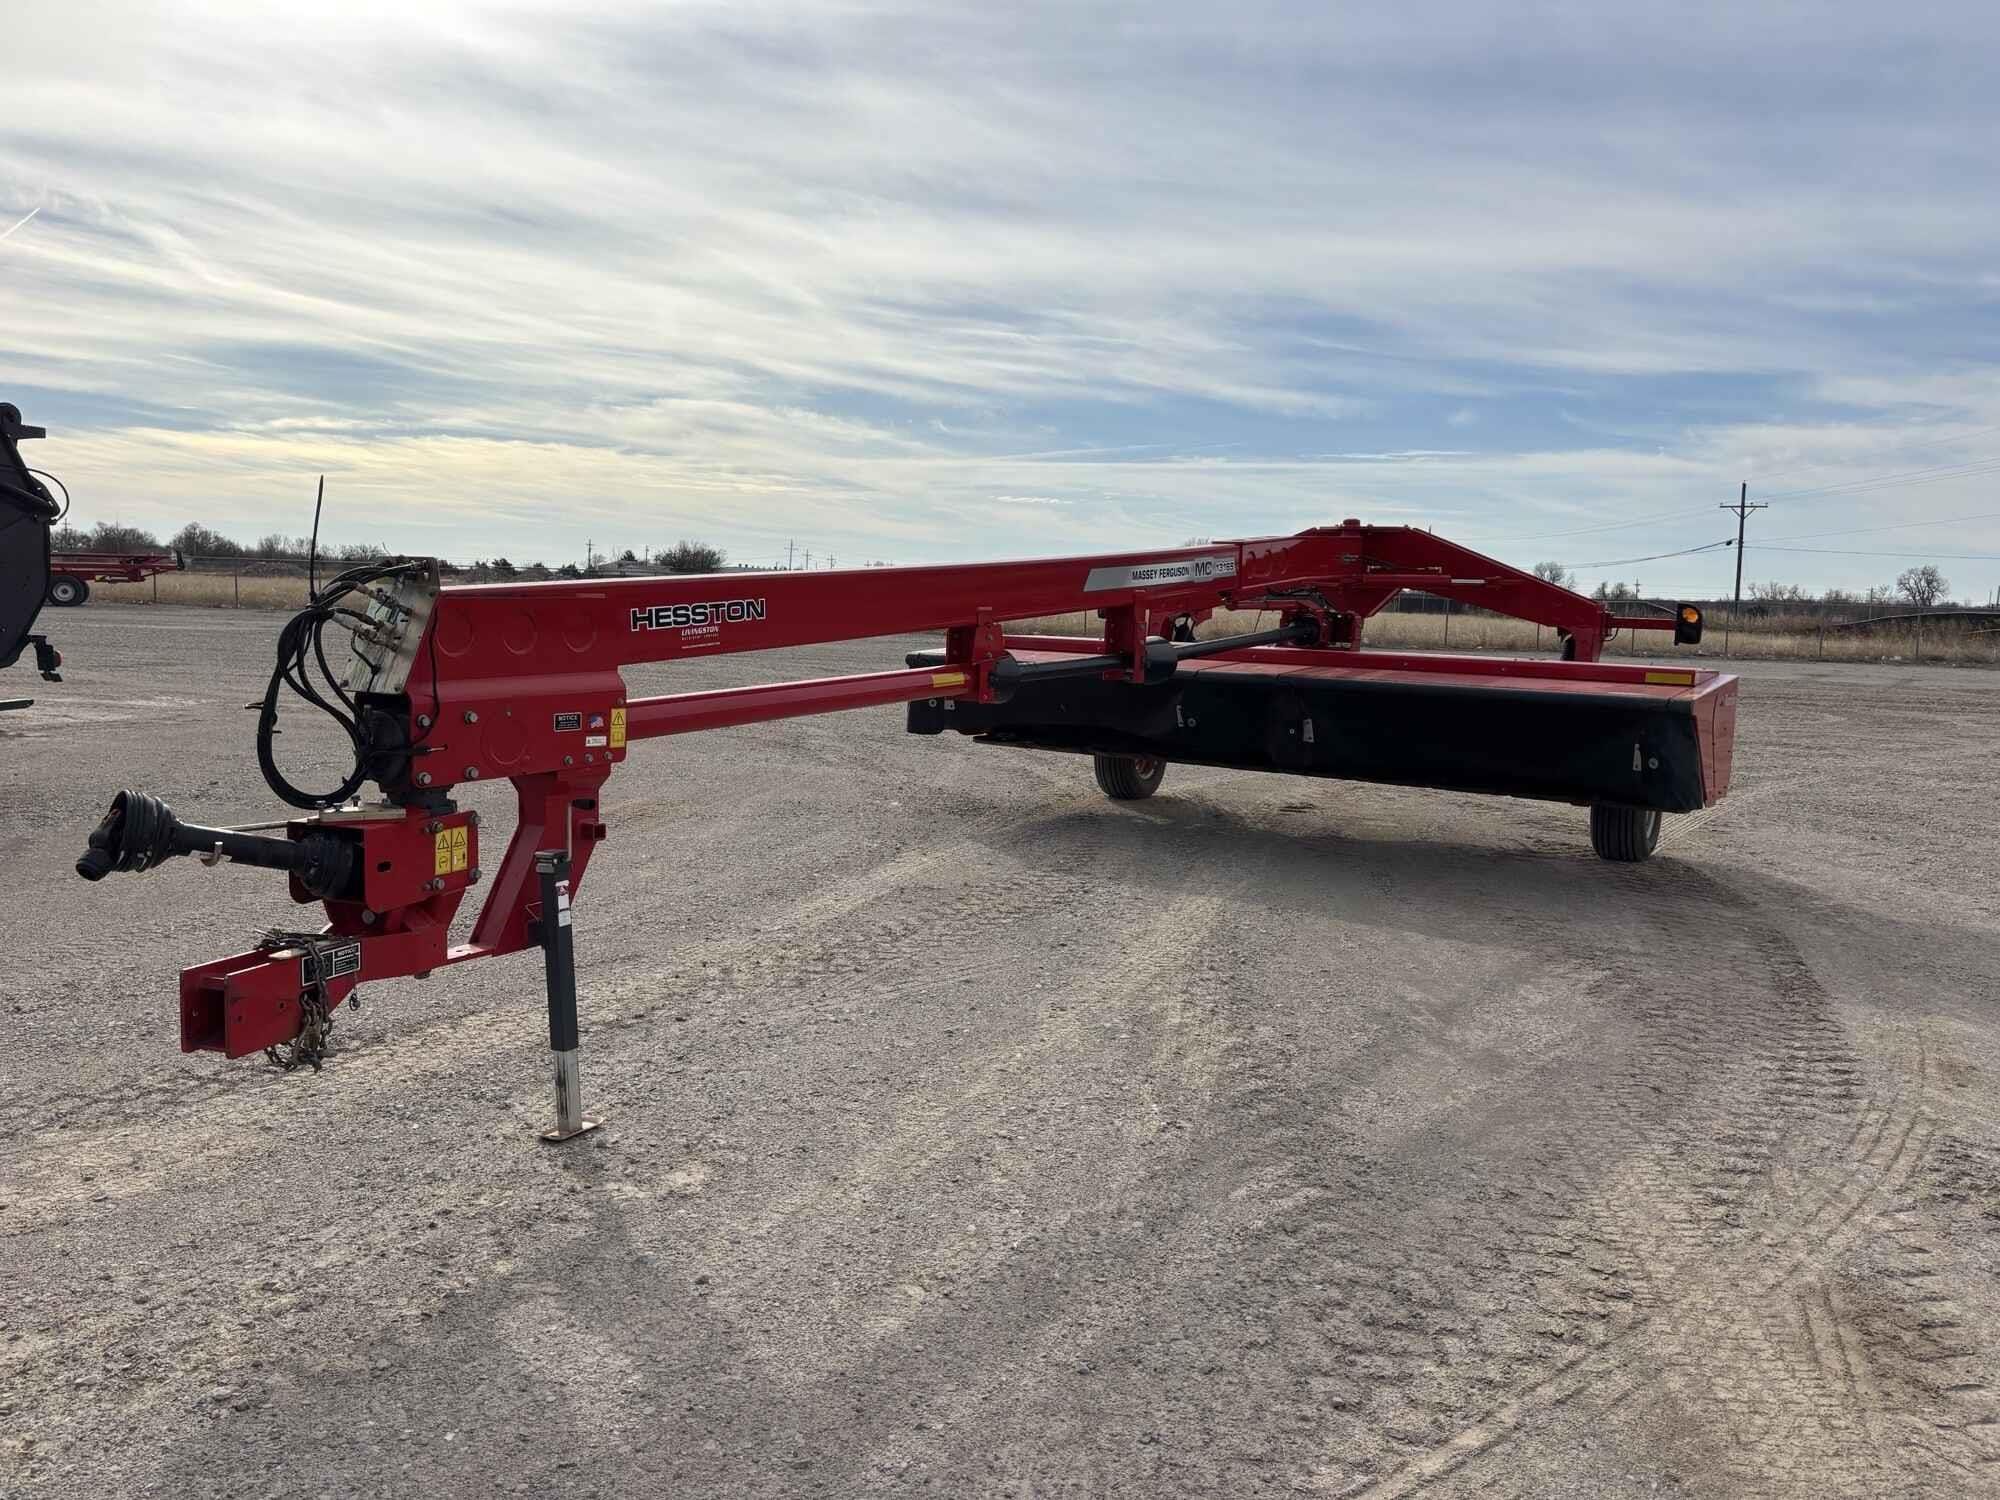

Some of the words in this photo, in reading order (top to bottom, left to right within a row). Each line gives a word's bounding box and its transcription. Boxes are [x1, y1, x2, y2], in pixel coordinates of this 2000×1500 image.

[1132, 568, 1157, 580] MASSEY
[1159, 566, 1190, 578] FERGUSON
[1195, 561, 1213, 577] MC
[630, 598, 766, 632] HESSTON
[681, 625, 719, 636] LIVINGSTON
